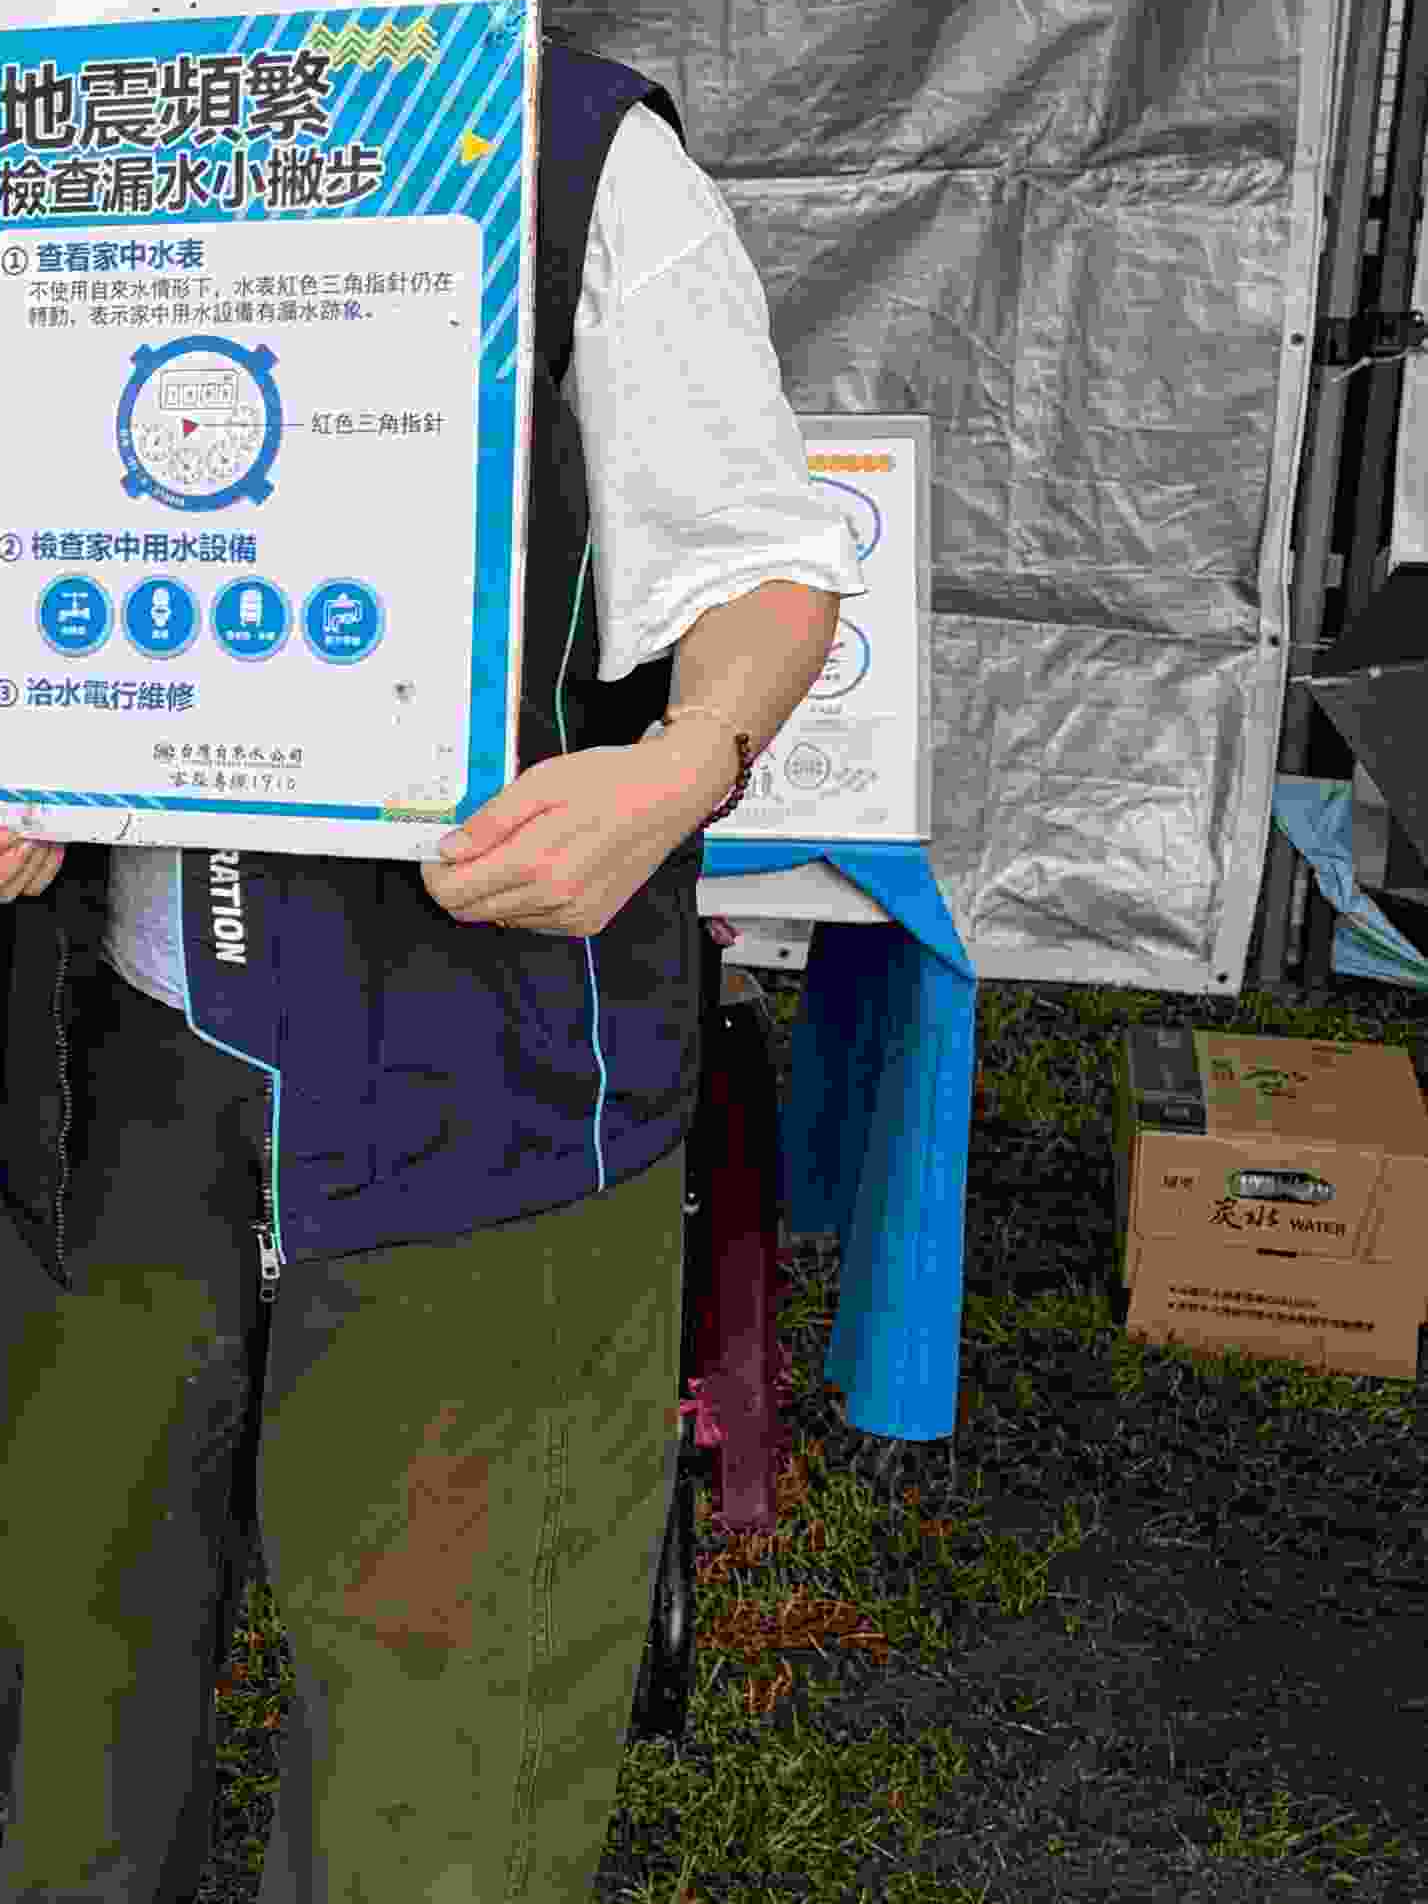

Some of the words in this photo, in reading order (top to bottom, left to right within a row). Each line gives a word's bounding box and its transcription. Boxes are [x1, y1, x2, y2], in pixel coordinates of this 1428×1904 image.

[37, 239, 204, 273] 查看家中水表
[31, 531, 257, 563] 檢查家中用水設備
